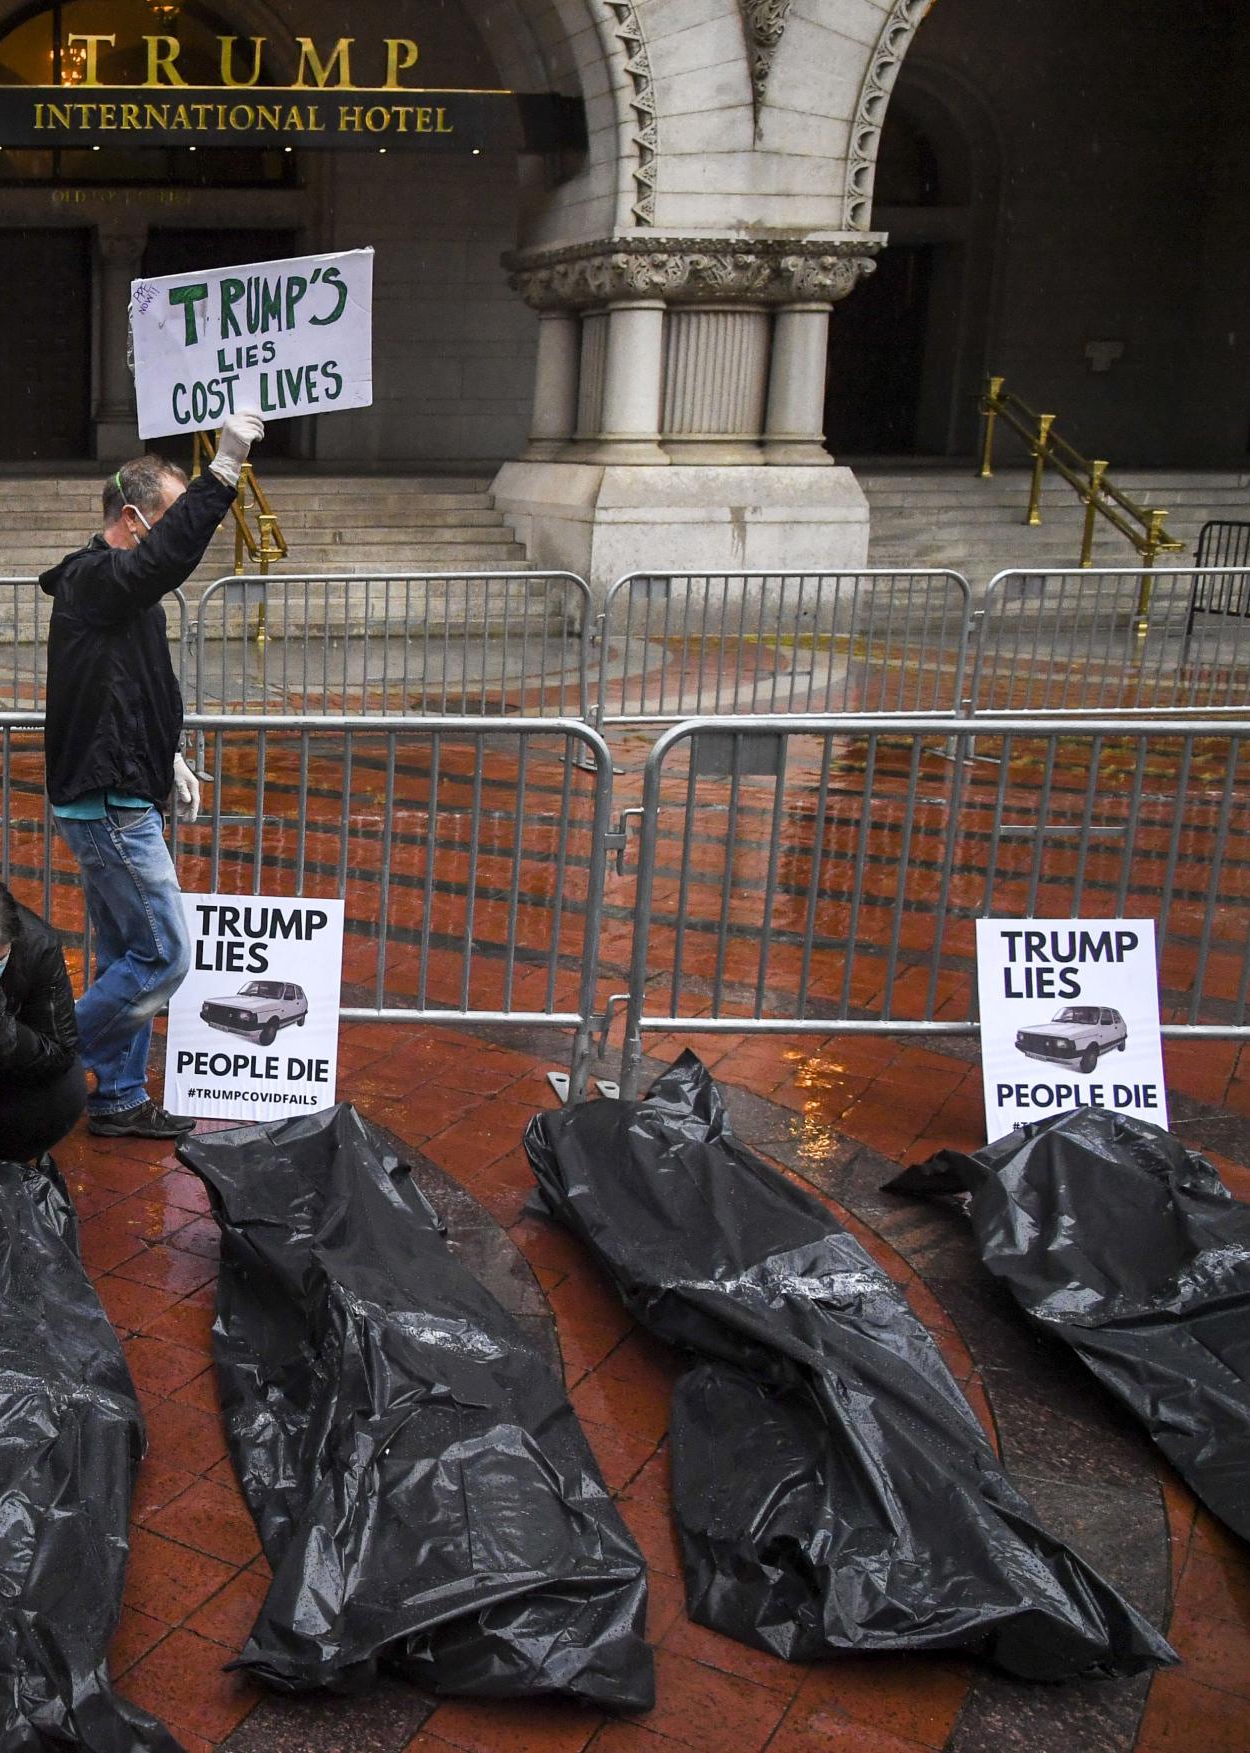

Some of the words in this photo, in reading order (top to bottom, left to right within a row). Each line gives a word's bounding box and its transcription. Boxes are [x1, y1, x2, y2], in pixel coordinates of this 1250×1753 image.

[67, 33, 420, 90] TRUMP
[34, 103, 326, 132] INTERNATIONAL
[338, 106, 453, 135] HOTEL
[217, 340, 276, 373] LIES
[172, 374, 240, 425] COST
[259, 360, 343, 412] LIVES
[196, 904, 328, 941] TRUMP
[194, 939, 269, 974] LIES
[1000, 930, 1139, 963] TRUMP
[1003, 966, 1082, 1000] LIES
[176, 1050, 280, 1080] PEOPLE
[286, 1057, 330, 1083] DIE
[187, 1087, 318, 1106] #TRUMPCOVIDFAILS
[996, 1083, 1105, 1108] PEOPLE
[1112, 1084, 1159, 1108] DIE
